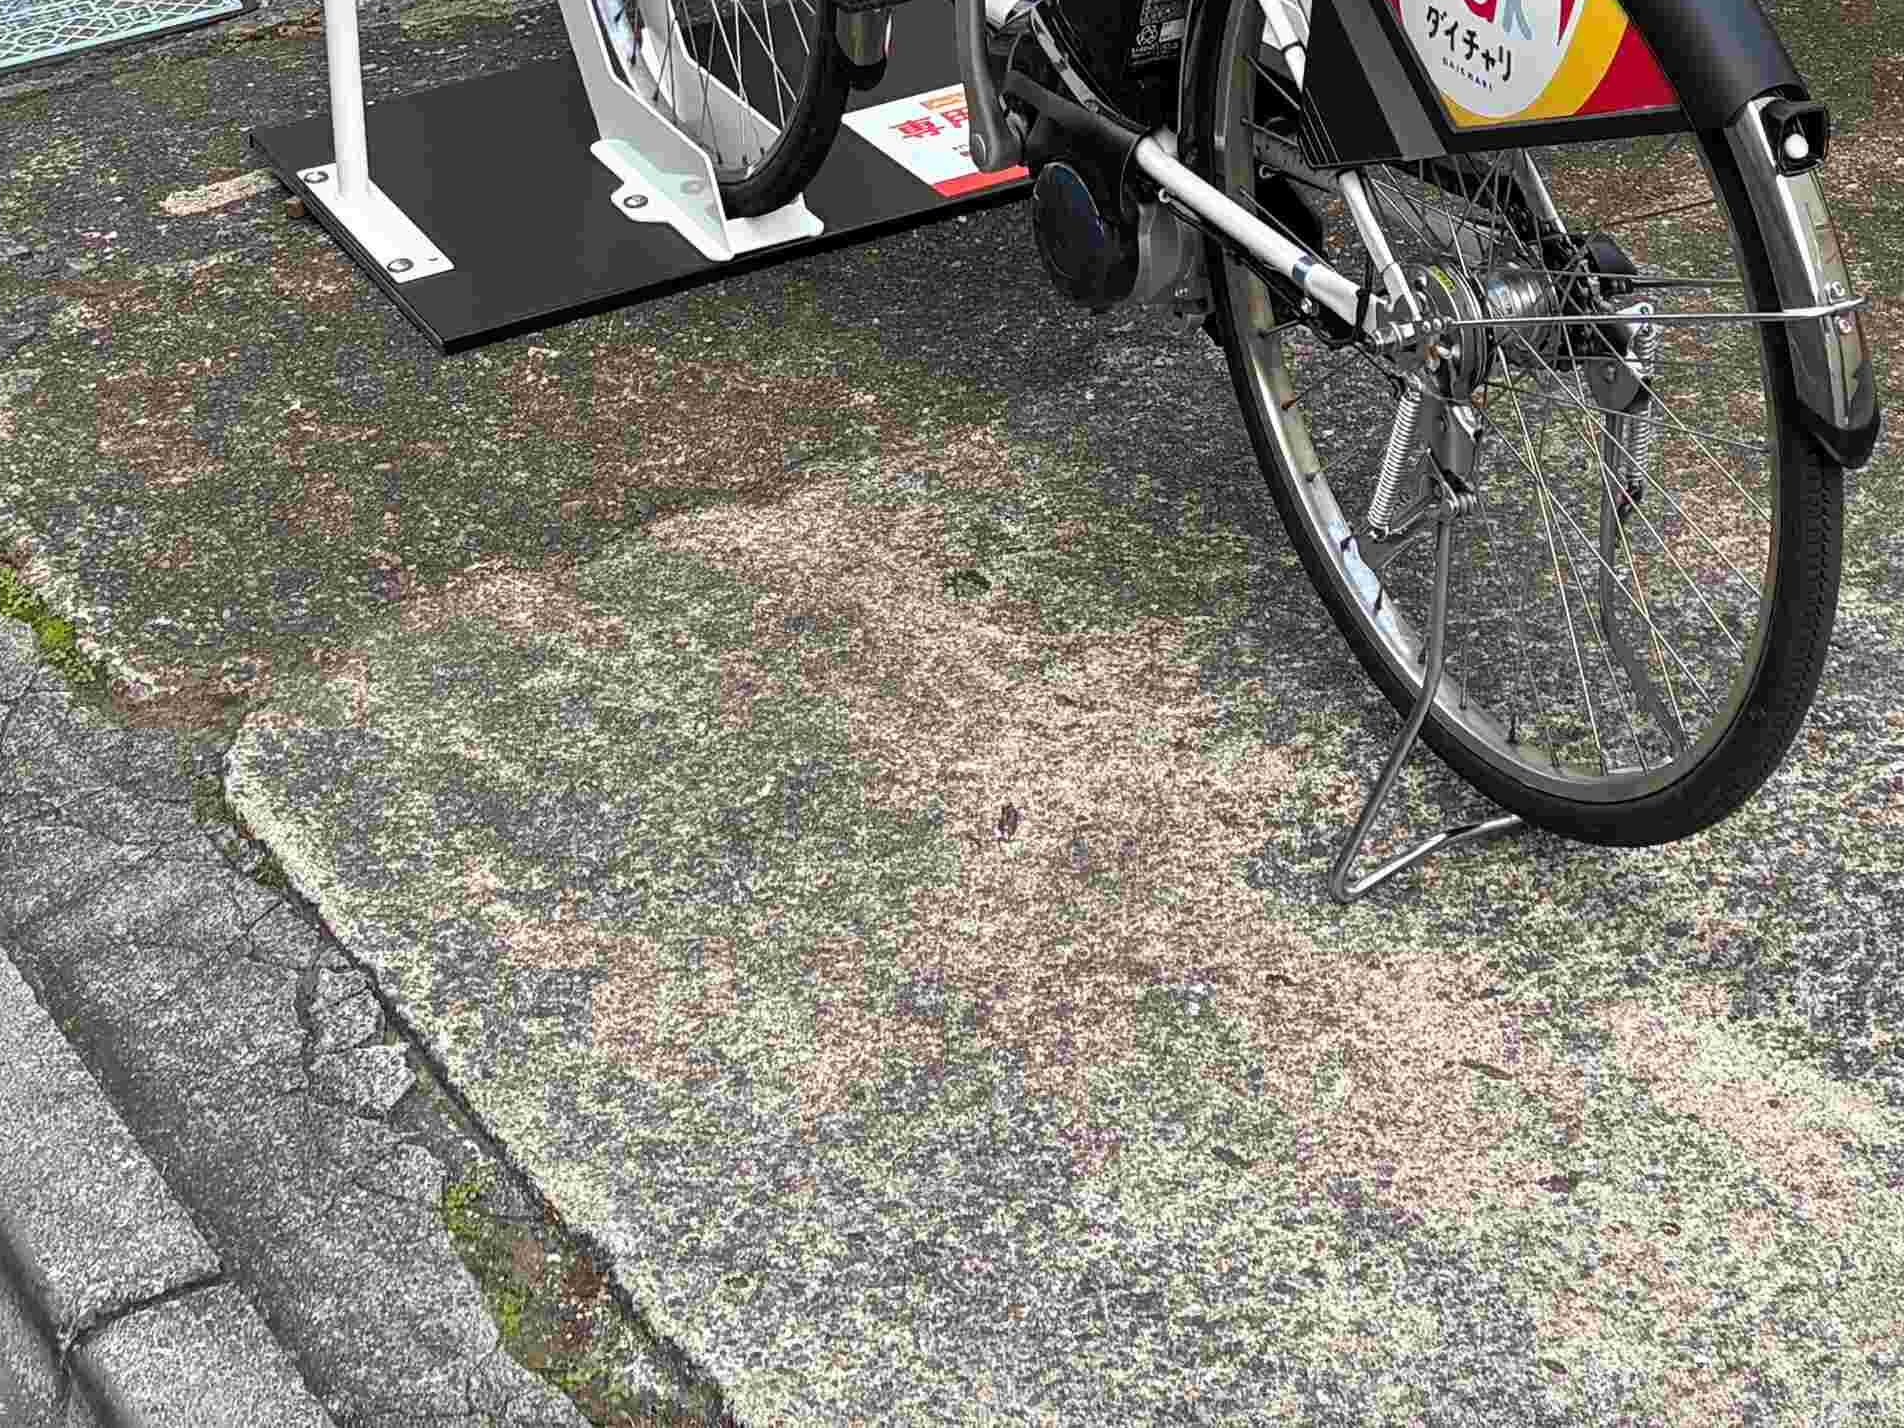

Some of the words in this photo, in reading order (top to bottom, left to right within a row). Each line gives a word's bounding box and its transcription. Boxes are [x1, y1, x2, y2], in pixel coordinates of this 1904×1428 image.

[1425, 5, 1512, 82] ダイチャリ
